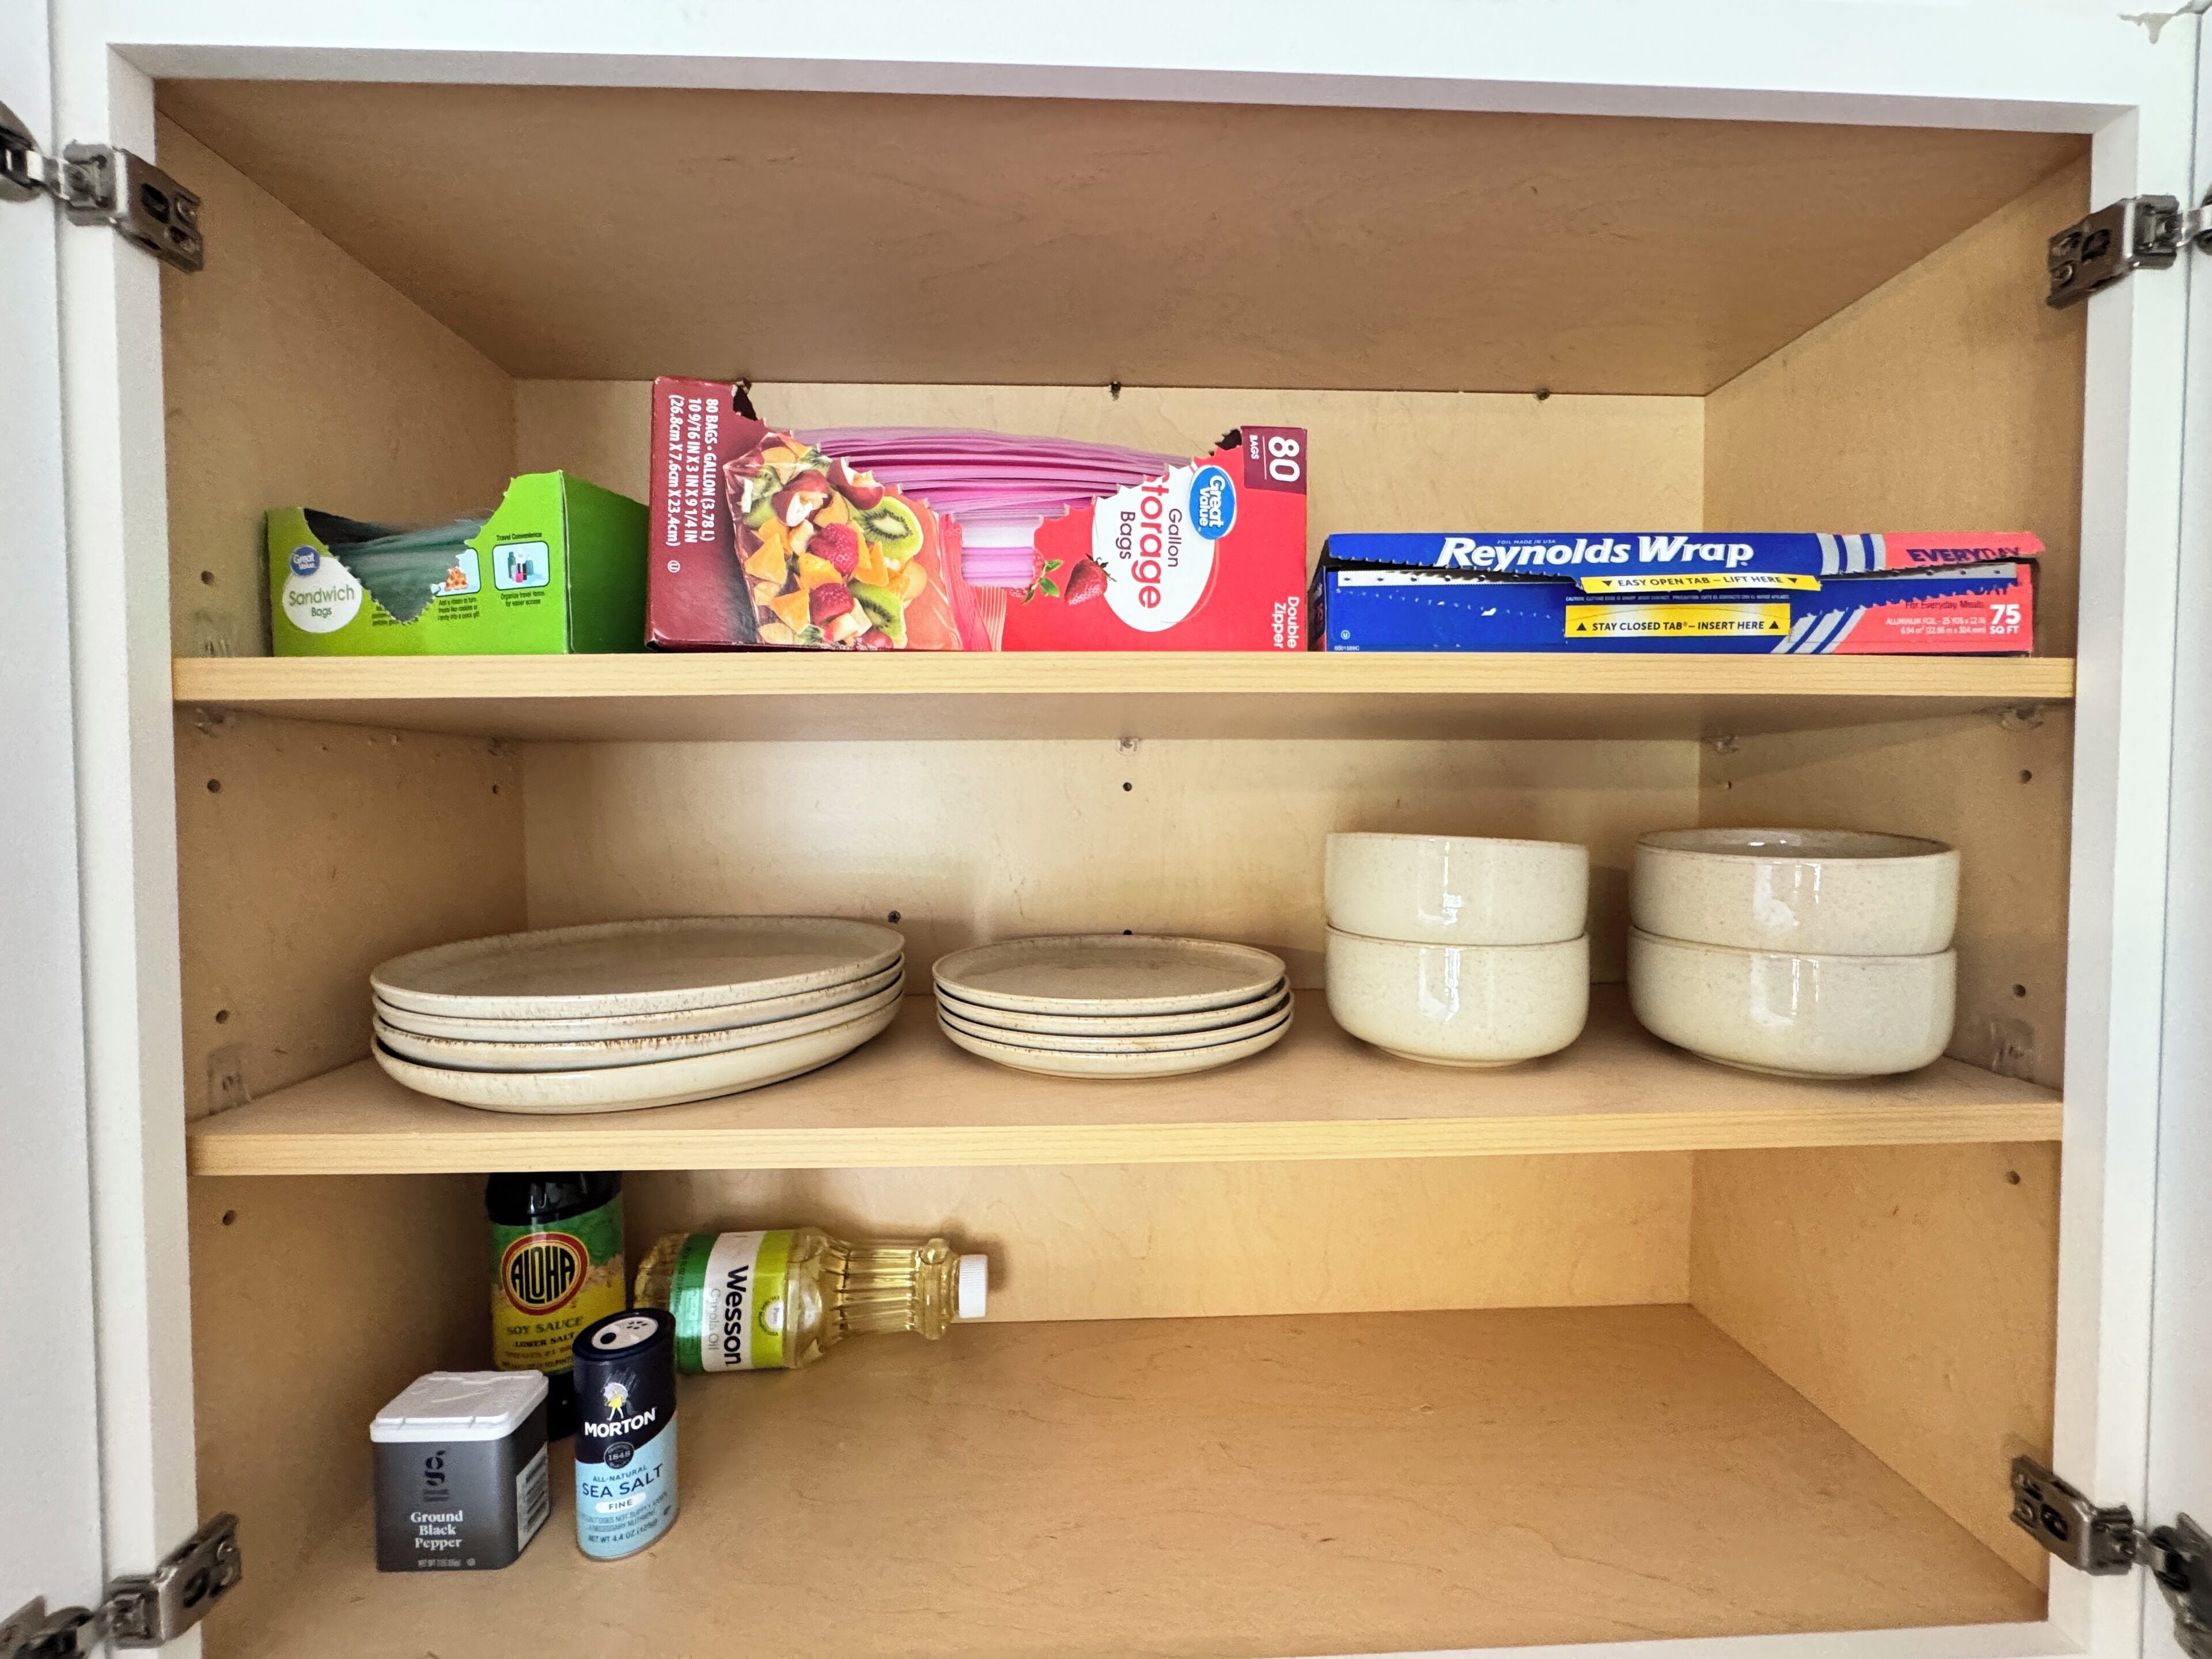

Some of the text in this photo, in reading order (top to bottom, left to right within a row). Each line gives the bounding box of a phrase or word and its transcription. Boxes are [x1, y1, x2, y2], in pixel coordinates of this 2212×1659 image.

[688, 398, 702, 412] 10
[706, 398, 719, 414] 80
[687, 414, 702, 440] 9/16
[704, 415, 719, 444] BAGS
[687, 441, 700, 454] IN
[1249, 435, 1260, 460] BAGS
[686, 456, 700, 464] X
[1268, 436, 1300, 482] 80
[665, 395, 685, 546] (26.8cm X 7.6cm X 23.4cm)
[702, 453, 717, 496] GALLON
[685, 475, 699, 487] IN
[685, 489, 698, 497] X
[1209, 475, 1226, 528] Great
[700, 499, 715, 528] (3.78
[1199, 487, 1211, 527] Value
[684, 509, 698, 527] 1/4
[684, 530, 698, 543] IN
[700, 530, 715, 541] L)
[1116, 511, 1136, 560] Bags
[1168, 508, 1183, 567] Gallon
[293, 552, 315, 564] Great
[1435, 536, 1754, 572] Reynolds Wrap
[289, 584, 355, 606] Sandwich
[311, 607, 332, 618] Bags
[1886, 617, 1921, 625] ALUMINUM
[1990, 604, 2021, 625] 75
[1271, 602, 1286, 649] Zipper
[1287, 596, 1300, 649] Double
[1592, 622, 1616, 631] STAY
[1620, 622, 1660, 631] CLOSED
[1698, 622, 1735, 630] INSERT
[1737, 621, 1764, 630] HERE
[1990, 626, 2019, 634] SQ FT
[511, 1245, 575, 1304] ALOHA
[708, 1288, 721, 1350] Canola Oil
[724, 1265, 749, 1365] Wesson
[507, 1326, 529, 1335] SOY
[550, 1332, 575, 1344] SALT
[585, 1407, 656, 1437] MORTON
[608, 1450, 631, 1461] 1848
[582, 1483, 613, 1498] SEA
[619, 1463, 662, 1495] SALT
[593, 1465, 647, 1482] ALL-NATURAL
[609, 1499, 633, 1510] FINE
[411, 1510, 463, 1523] Ground
[419, 1524, 457, 1536] Black
[626, 1530, 636, 1538] OZ
[415, 1537, 463, 1551] Pepper
